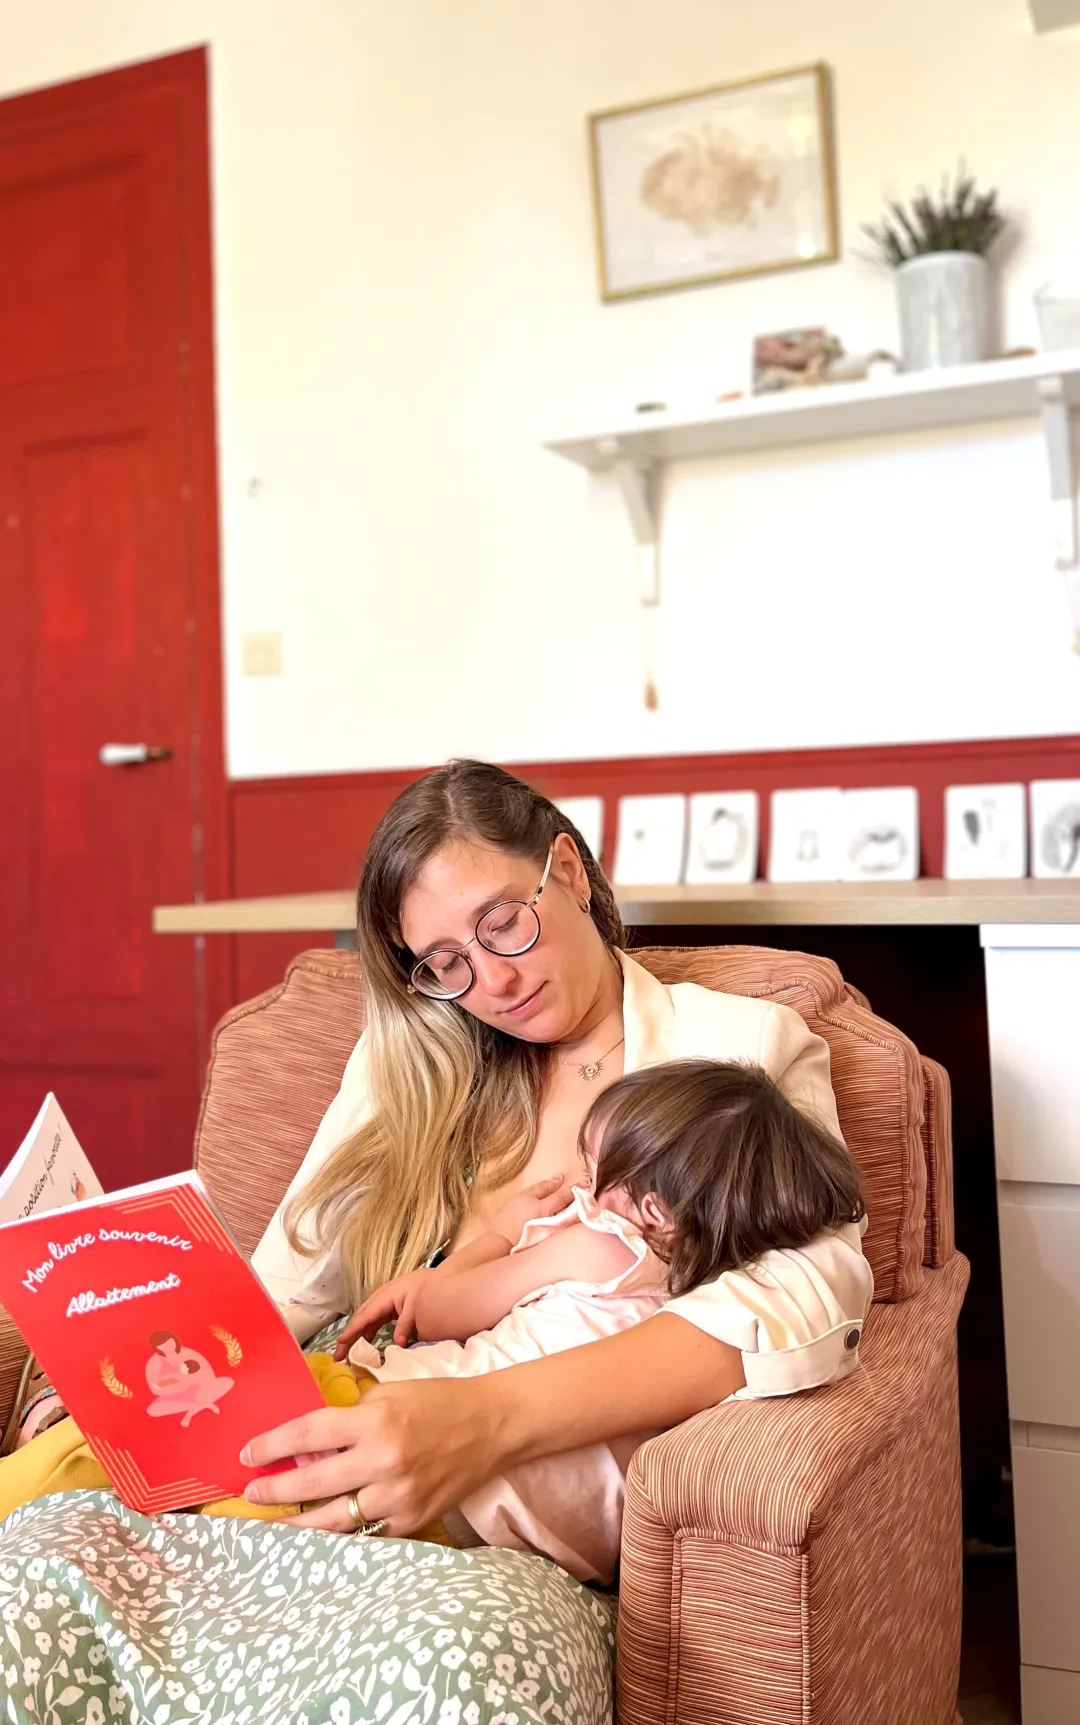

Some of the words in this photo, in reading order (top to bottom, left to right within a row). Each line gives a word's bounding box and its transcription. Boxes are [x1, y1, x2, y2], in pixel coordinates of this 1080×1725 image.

[22, 1259, 54, 1293] Mon
[48, 1232, 95, 1260] livre
[98, 1228, 193, 1251] souvenir
[66, 1272, 182, 1318] Allaitement
